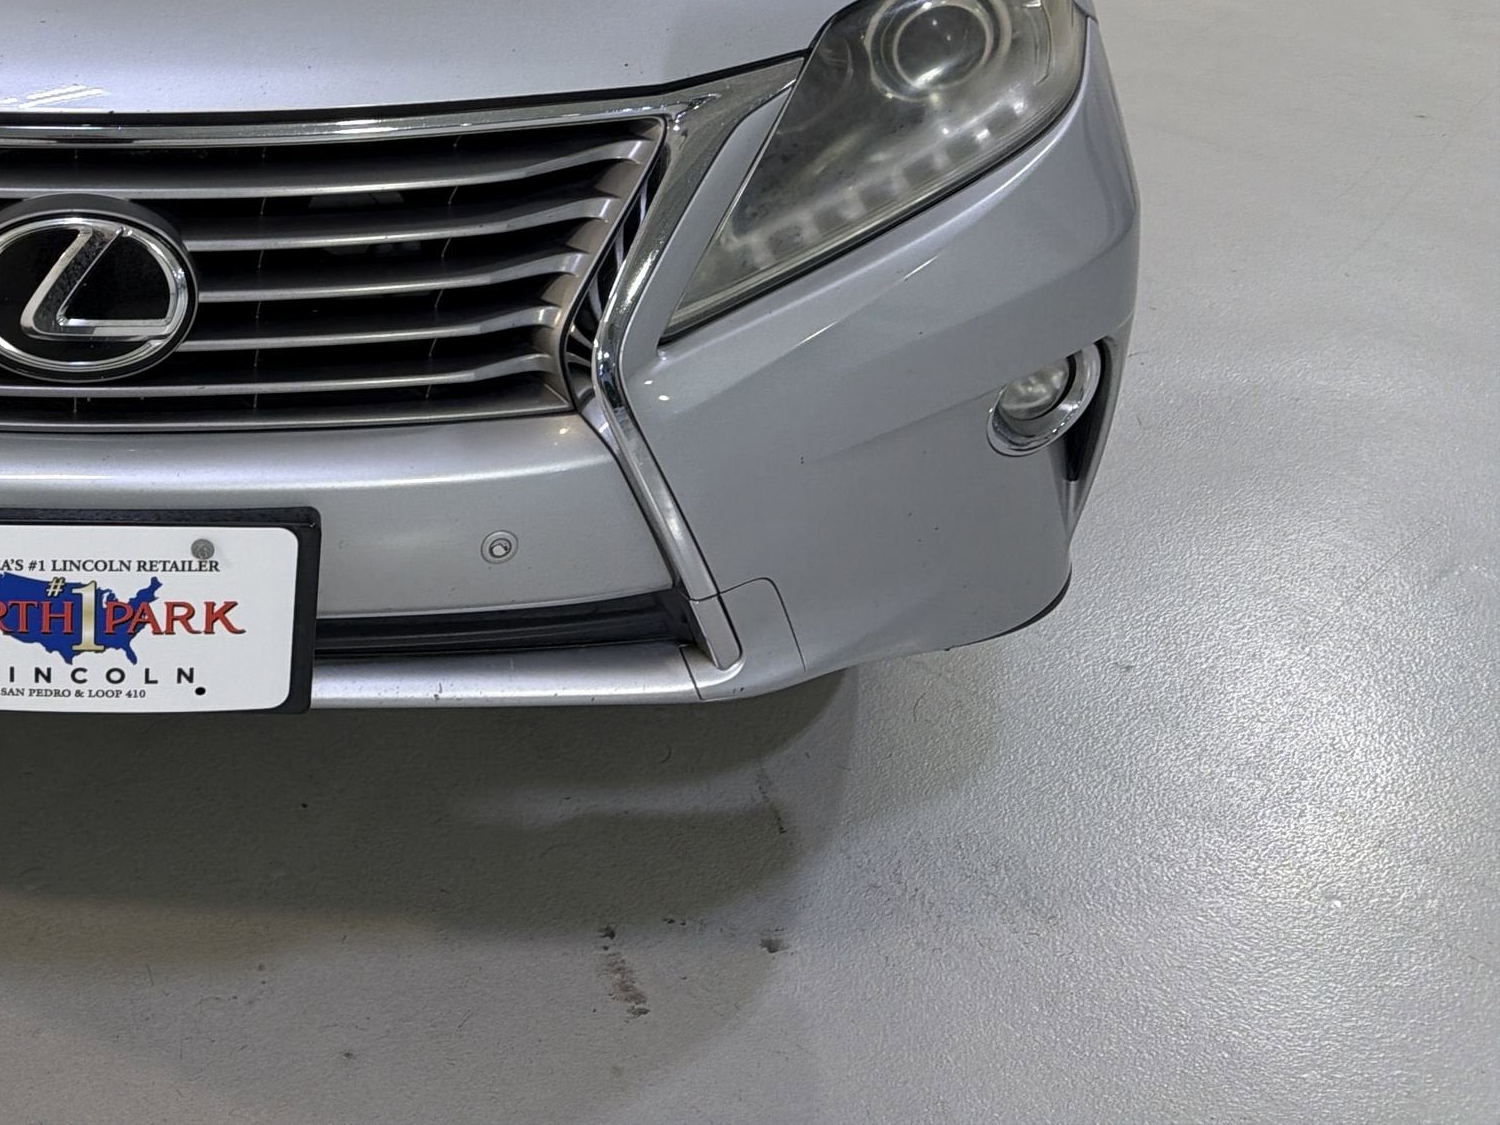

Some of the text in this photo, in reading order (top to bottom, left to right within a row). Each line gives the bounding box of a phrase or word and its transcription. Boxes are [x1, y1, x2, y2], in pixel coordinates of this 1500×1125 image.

[28, 559, 46, 572] #1
[51, 559, 132, 573] LINCOLN
[136, 559, 221, 573] RETAILER
[104, 600, 247, 635] PARK
[0, 687, 147, 699] SAN PEDRO & LOOP 410
